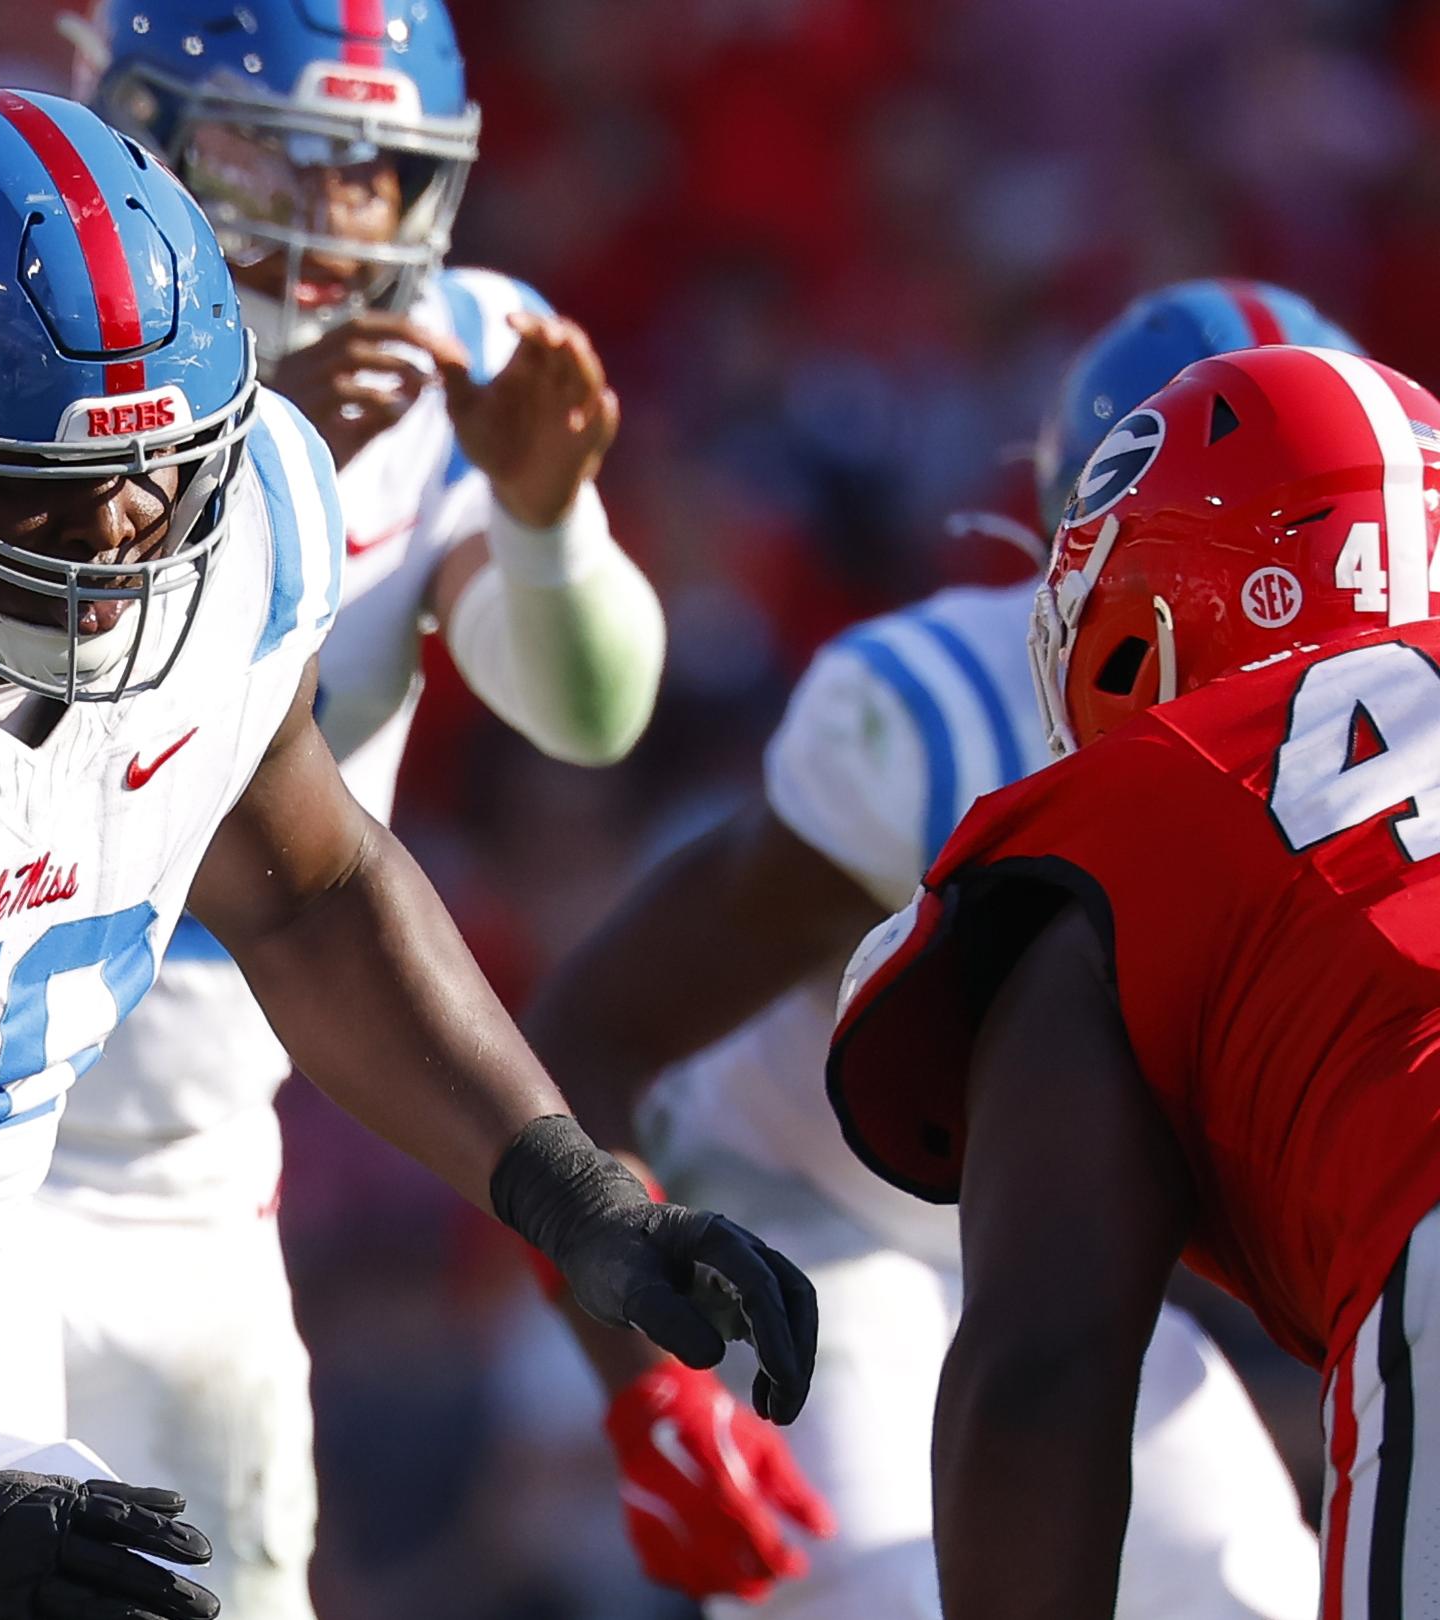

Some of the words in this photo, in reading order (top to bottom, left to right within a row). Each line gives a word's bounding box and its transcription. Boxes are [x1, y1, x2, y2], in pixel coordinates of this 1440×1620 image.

[86, 396, 175, 437] REBS
[1247, 572, 1296, 621] SEC
[6, 850, 79, 918] Miss
